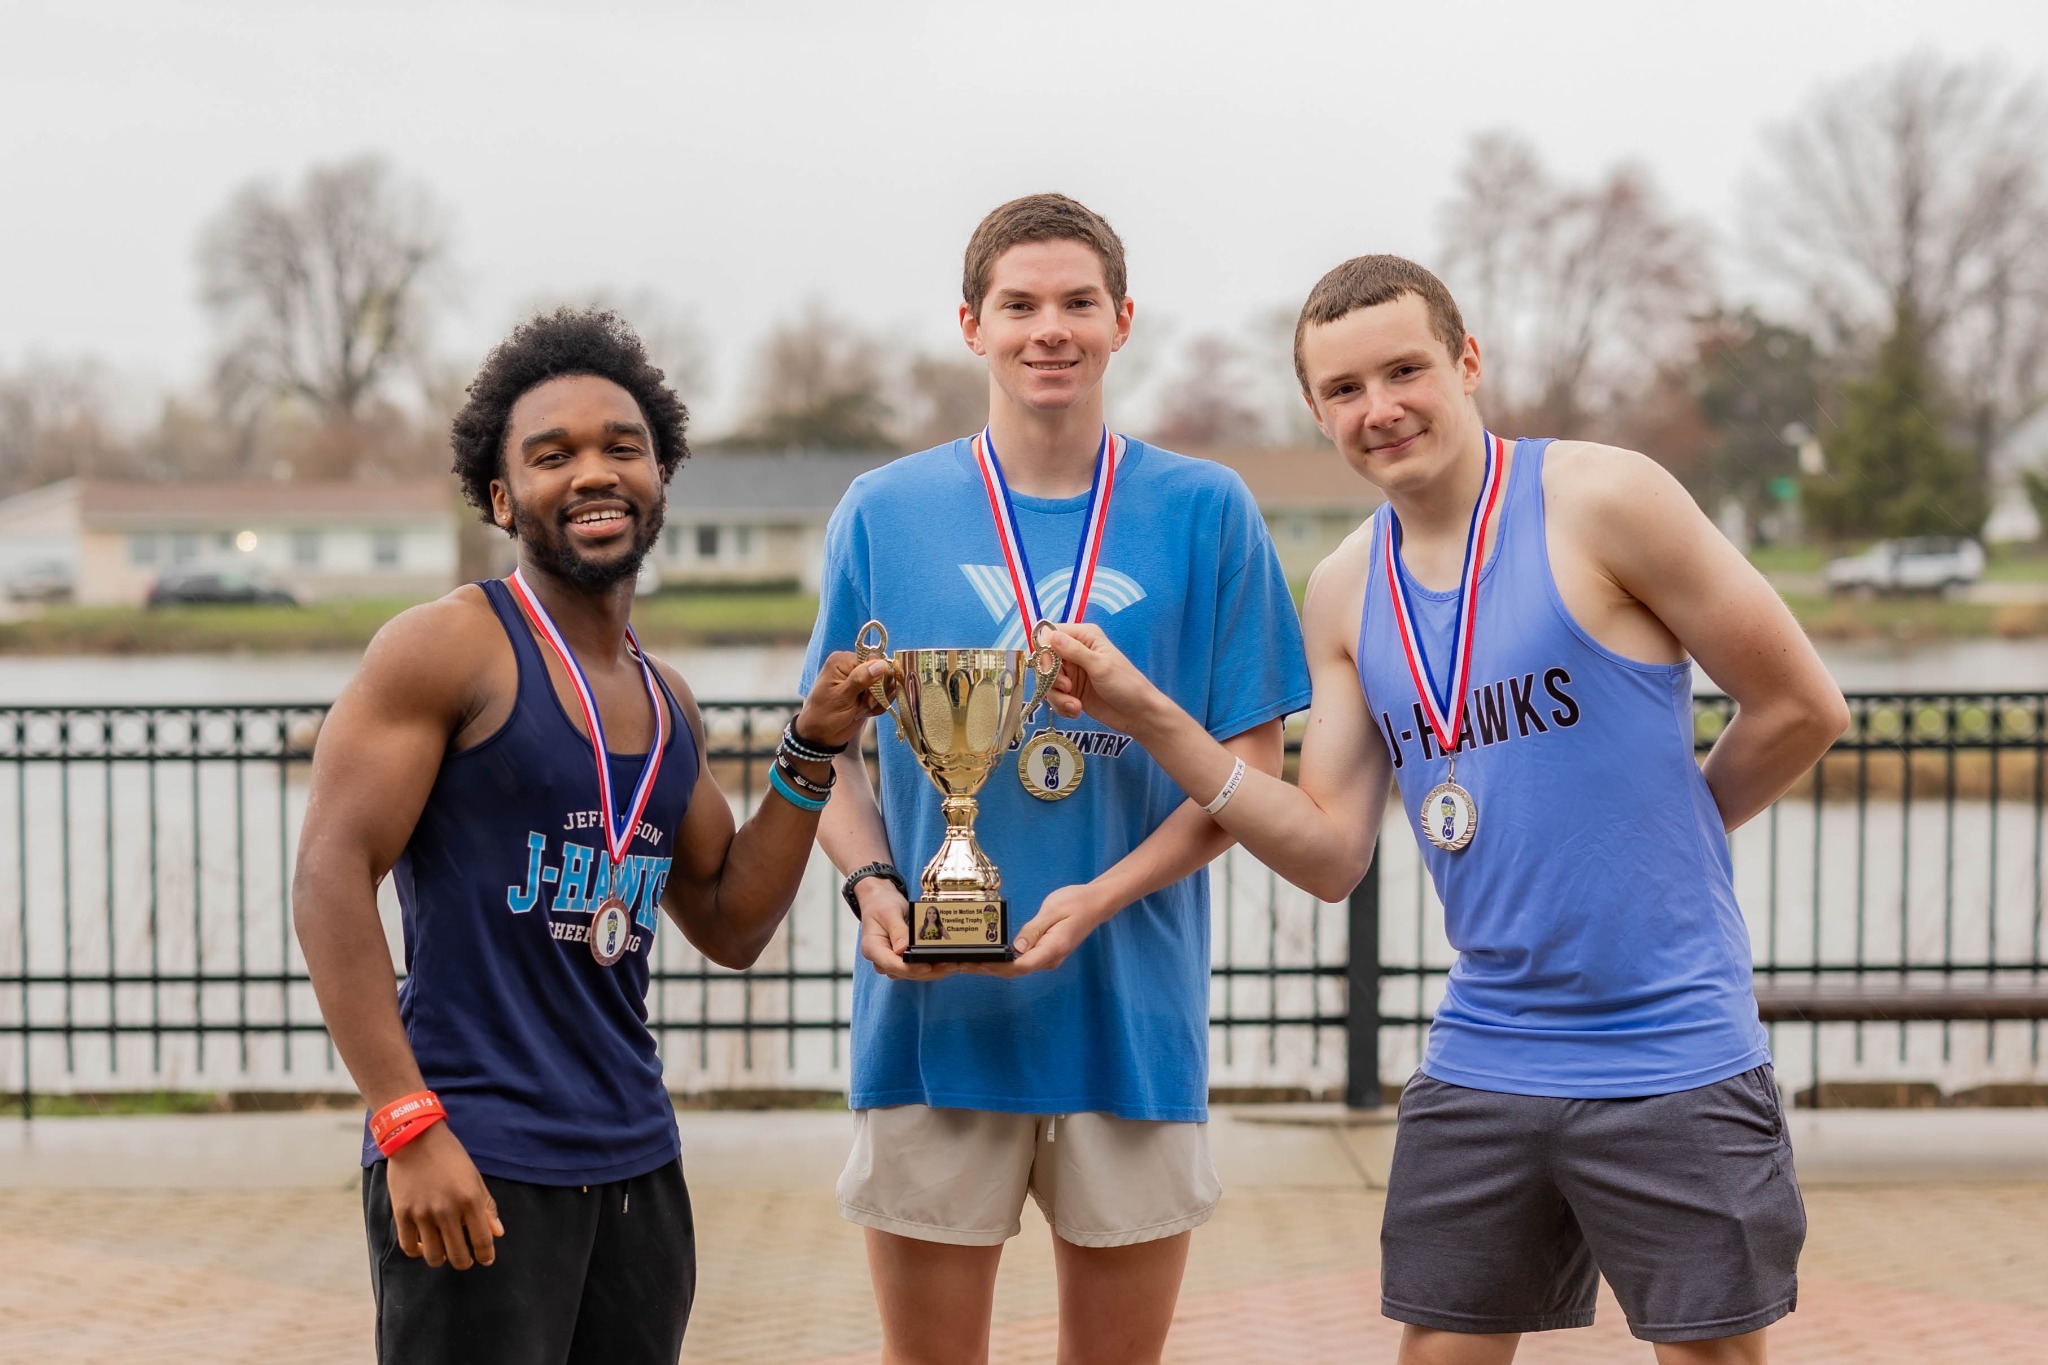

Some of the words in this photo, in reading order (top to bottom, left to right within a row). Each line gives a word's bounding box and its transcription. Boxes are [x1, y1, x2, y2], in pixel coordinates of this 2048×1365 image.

[1382, 666, 1581, 770] J-HAWKS
[1032, 728, 1134, 759] UNTRY
[563, 810, 664, 847] JEFSON
[390, 1100, 421, 1120] JOSHUA
